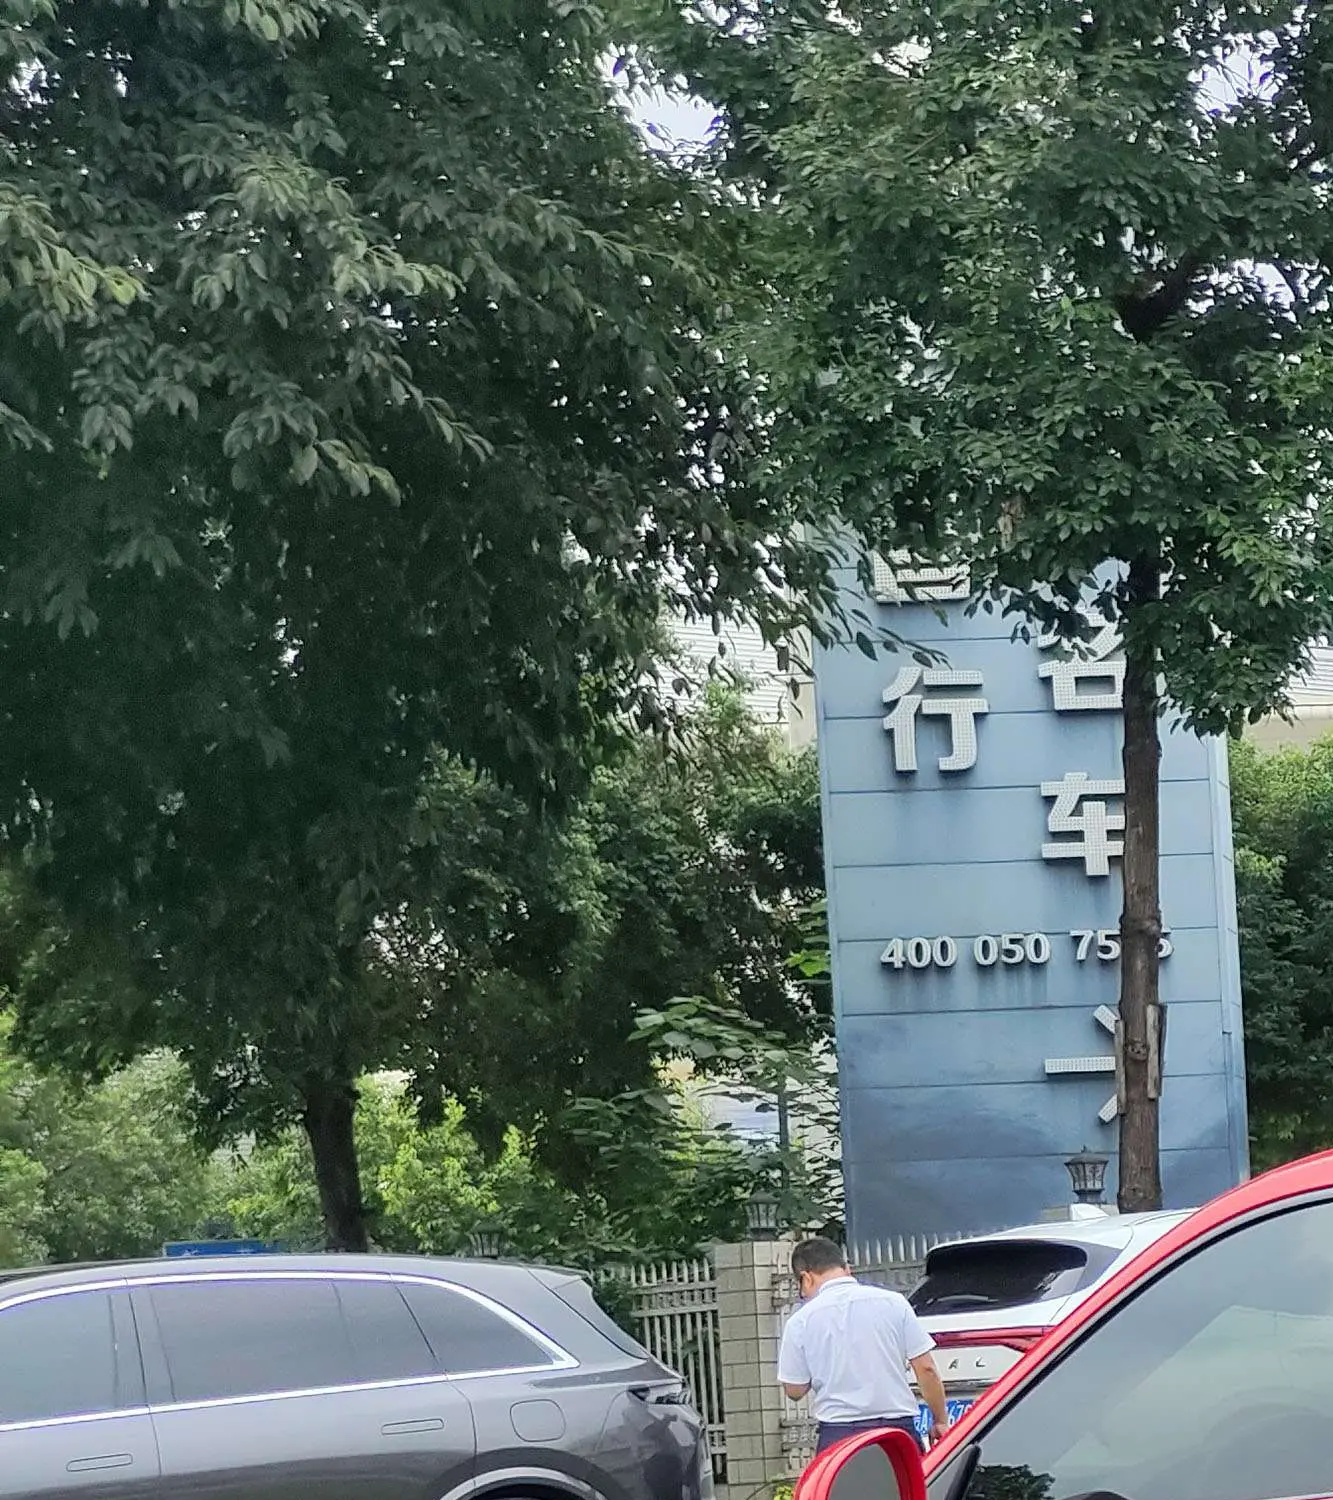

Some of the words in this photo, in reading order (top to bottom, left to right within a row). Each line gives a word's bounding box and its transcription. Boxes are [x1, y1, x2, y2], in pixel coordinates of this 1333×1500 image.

[880, 936, 958, 969] 400
[973, 932, 1051, 966] 050
[1070, 928, 1174, 962] 755
